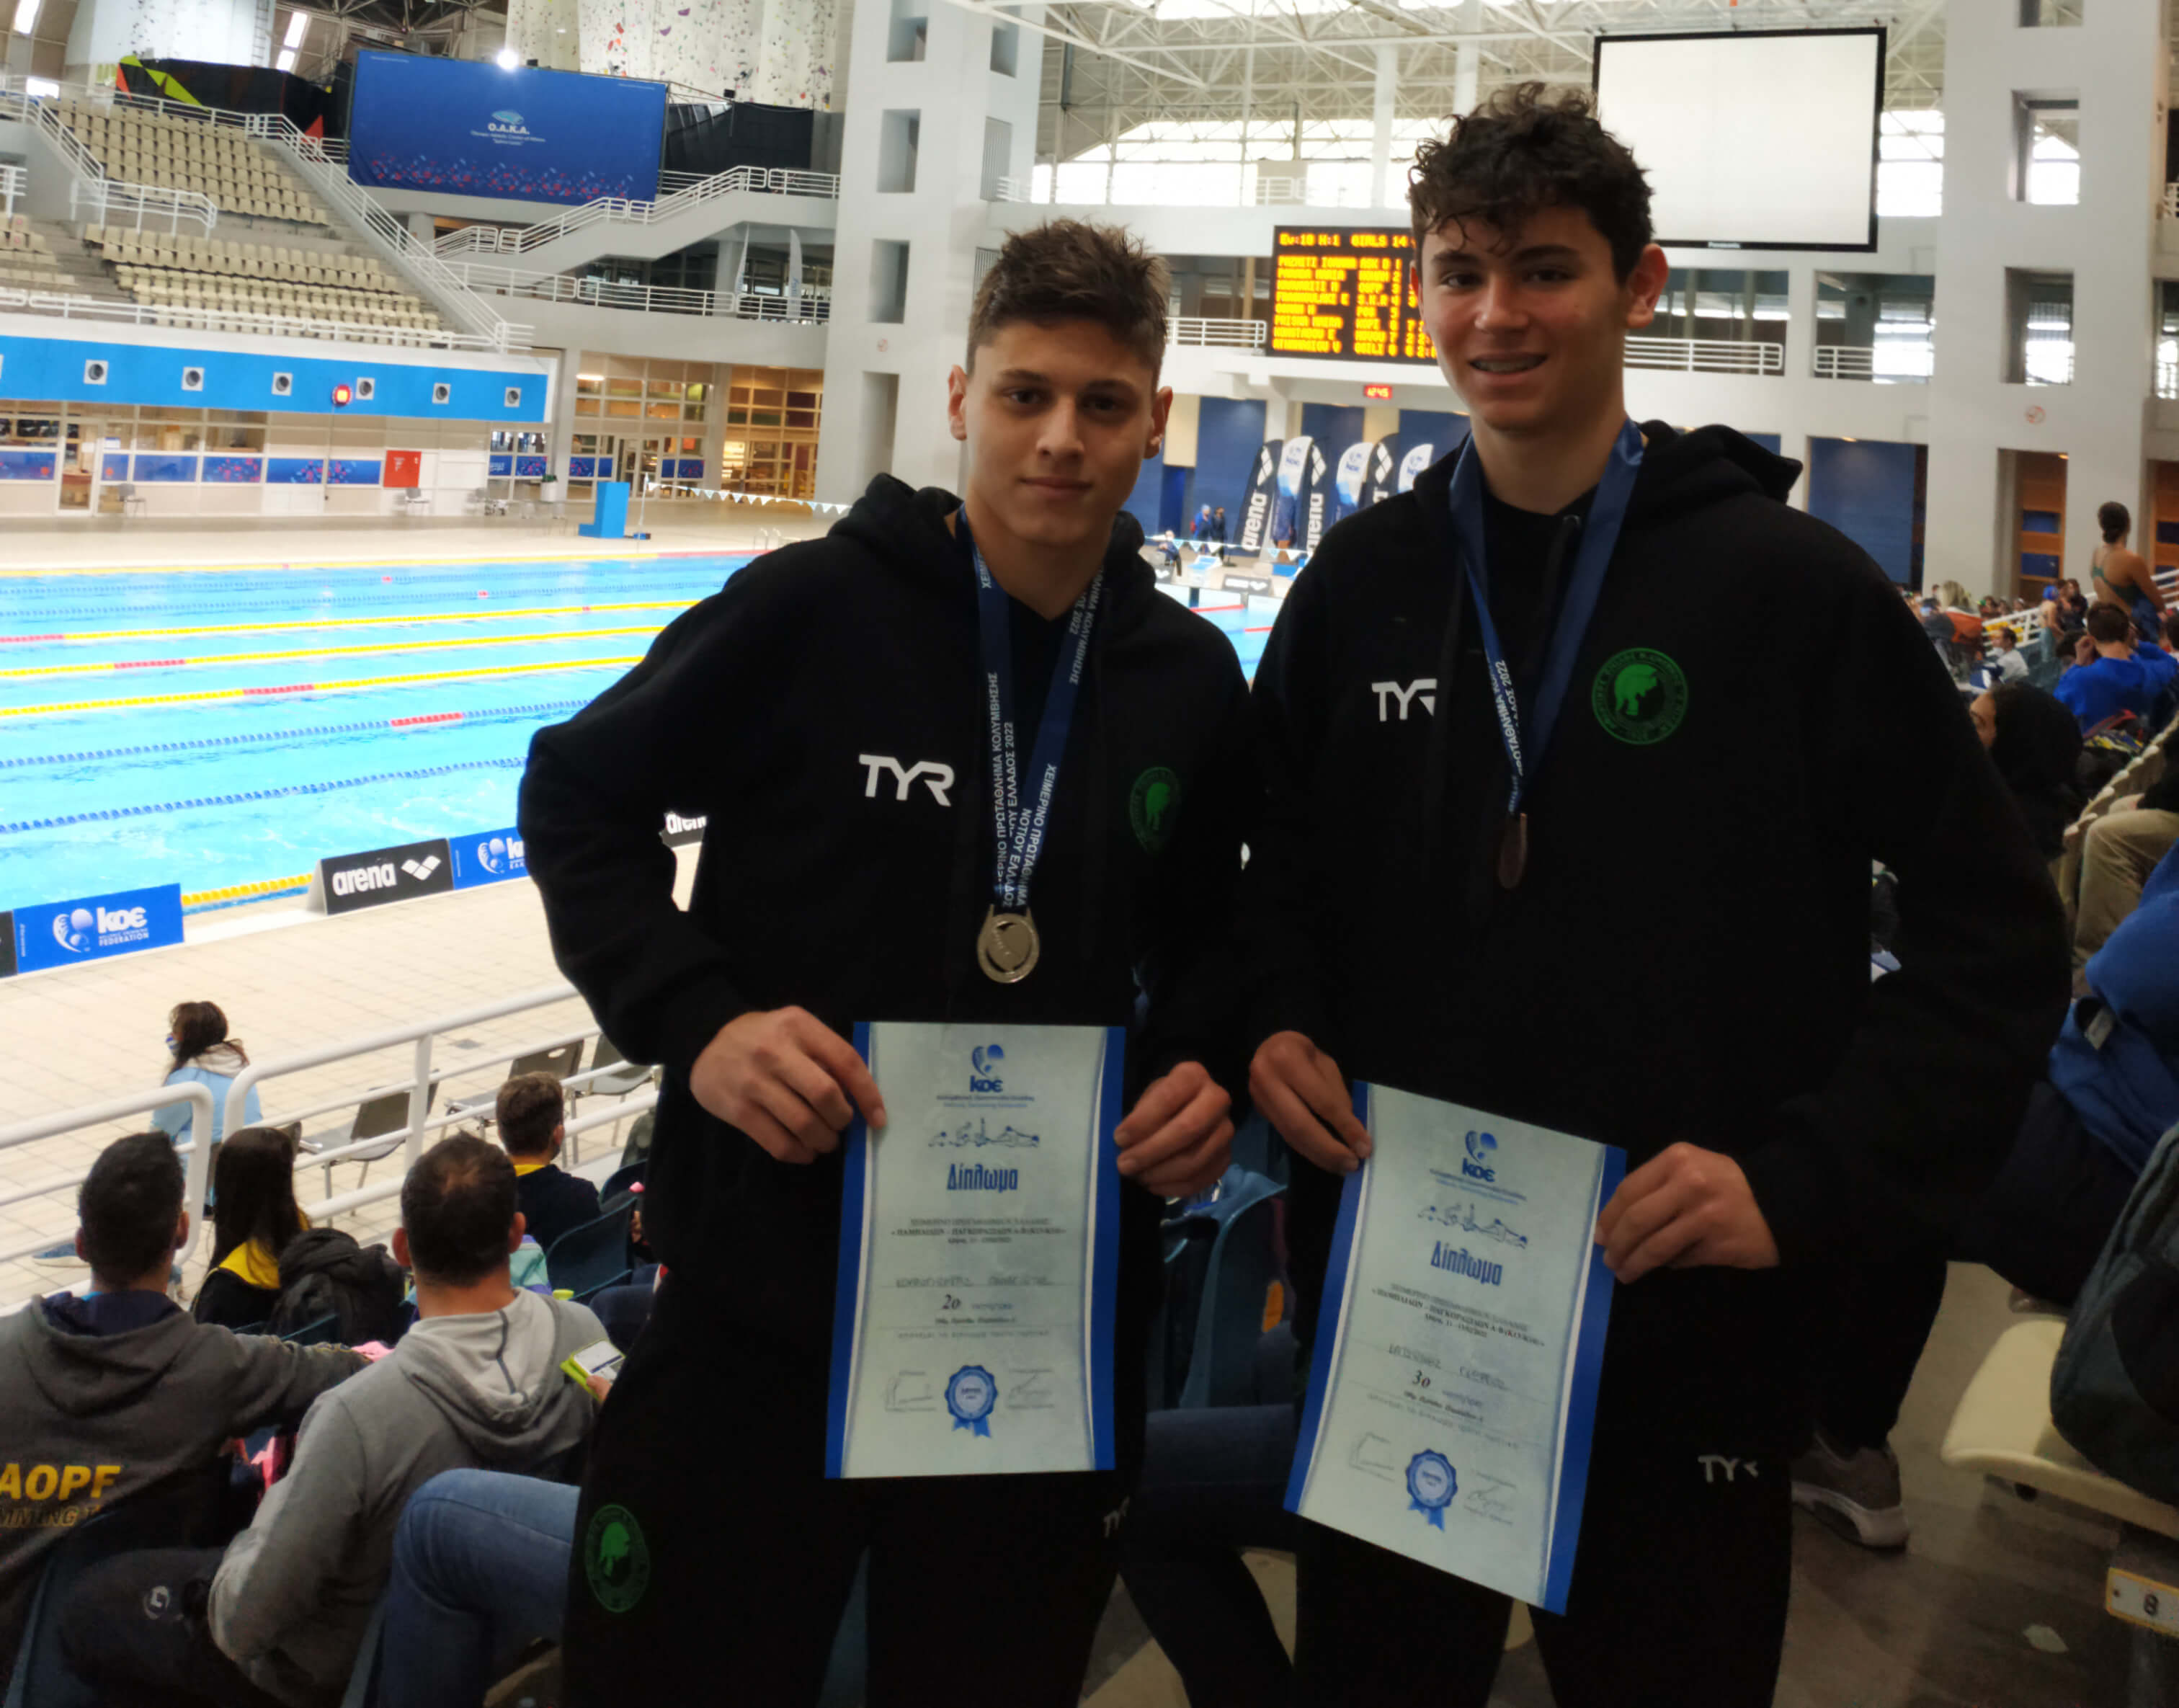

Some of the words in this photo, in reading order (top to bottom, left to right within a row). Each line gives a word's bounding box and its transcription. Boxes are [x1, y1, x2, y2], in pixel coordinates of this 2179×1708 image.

[1241, 492, 1267, 551] arena
[858, 753, 955, 807] TYR
[332, 863, 397, 896] arena
[947, 1162, 1018, 1193] Δίπλωμα
[1430, 1240, 1503, 1286] Δίπλωμα
